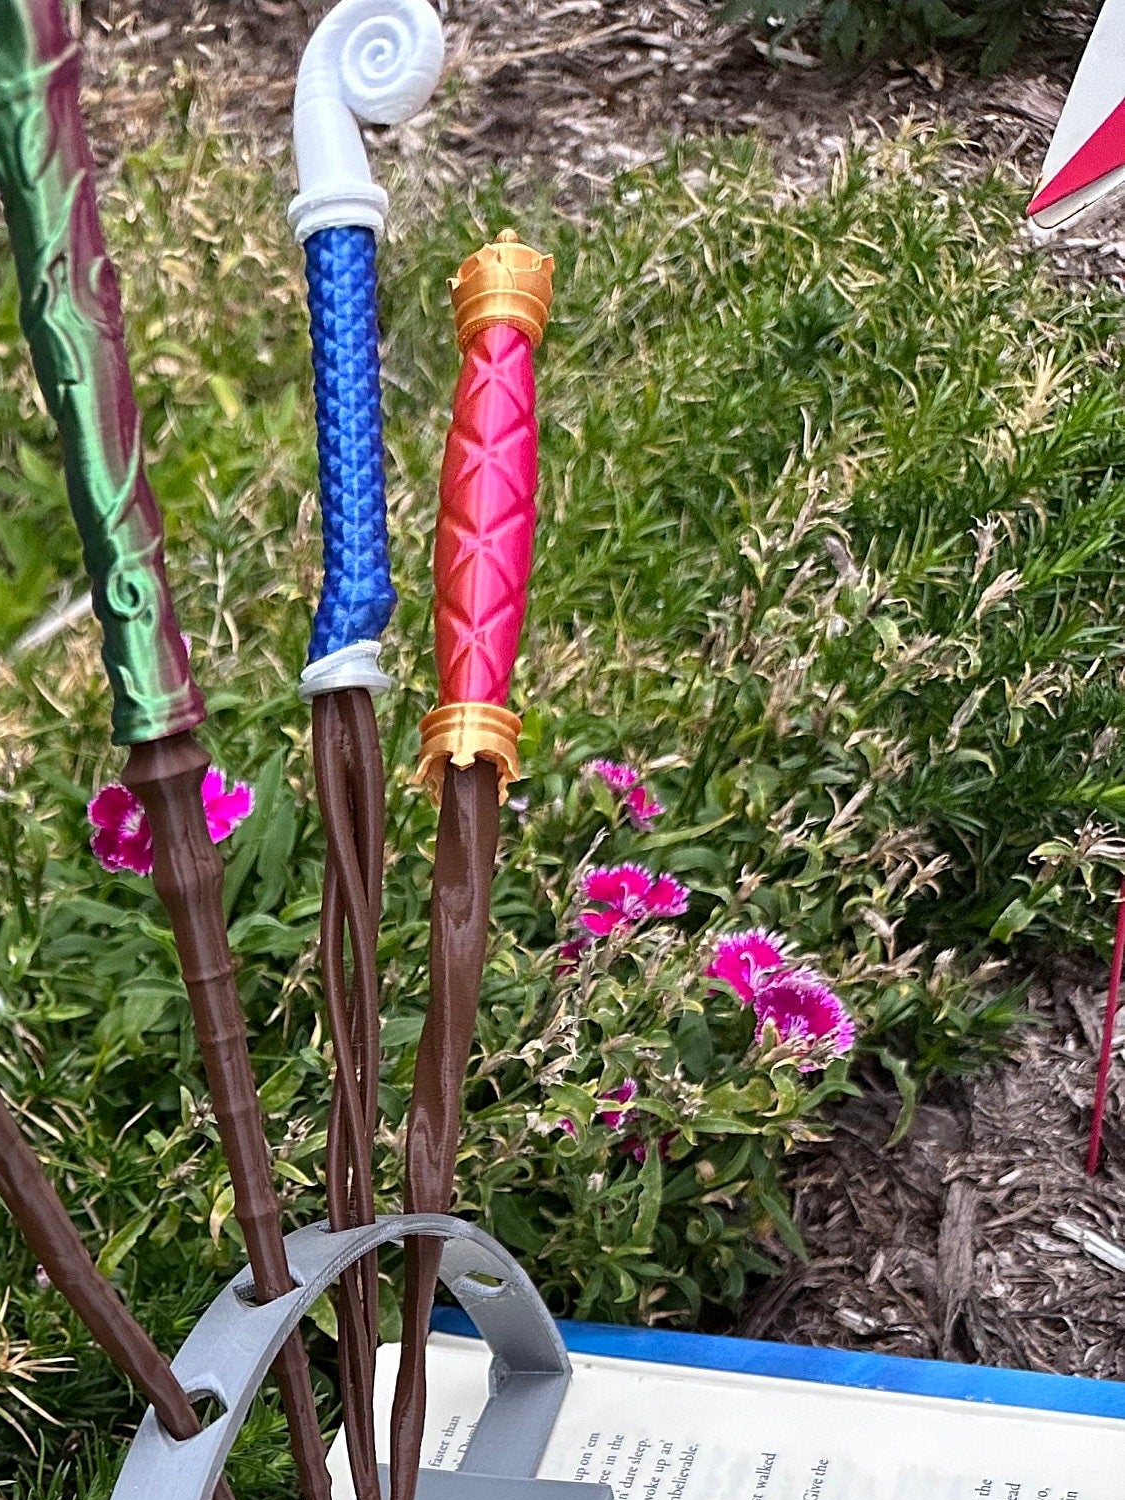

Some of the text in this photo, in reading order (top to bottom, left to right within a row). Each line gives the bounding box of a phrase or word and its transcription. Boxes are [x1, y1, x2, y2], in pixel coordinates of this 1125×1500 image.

[428, 1415, 462, 1468] faster than
[755, 1452, 777, 1489] walked
[974, 1479, 993, 1497] the
